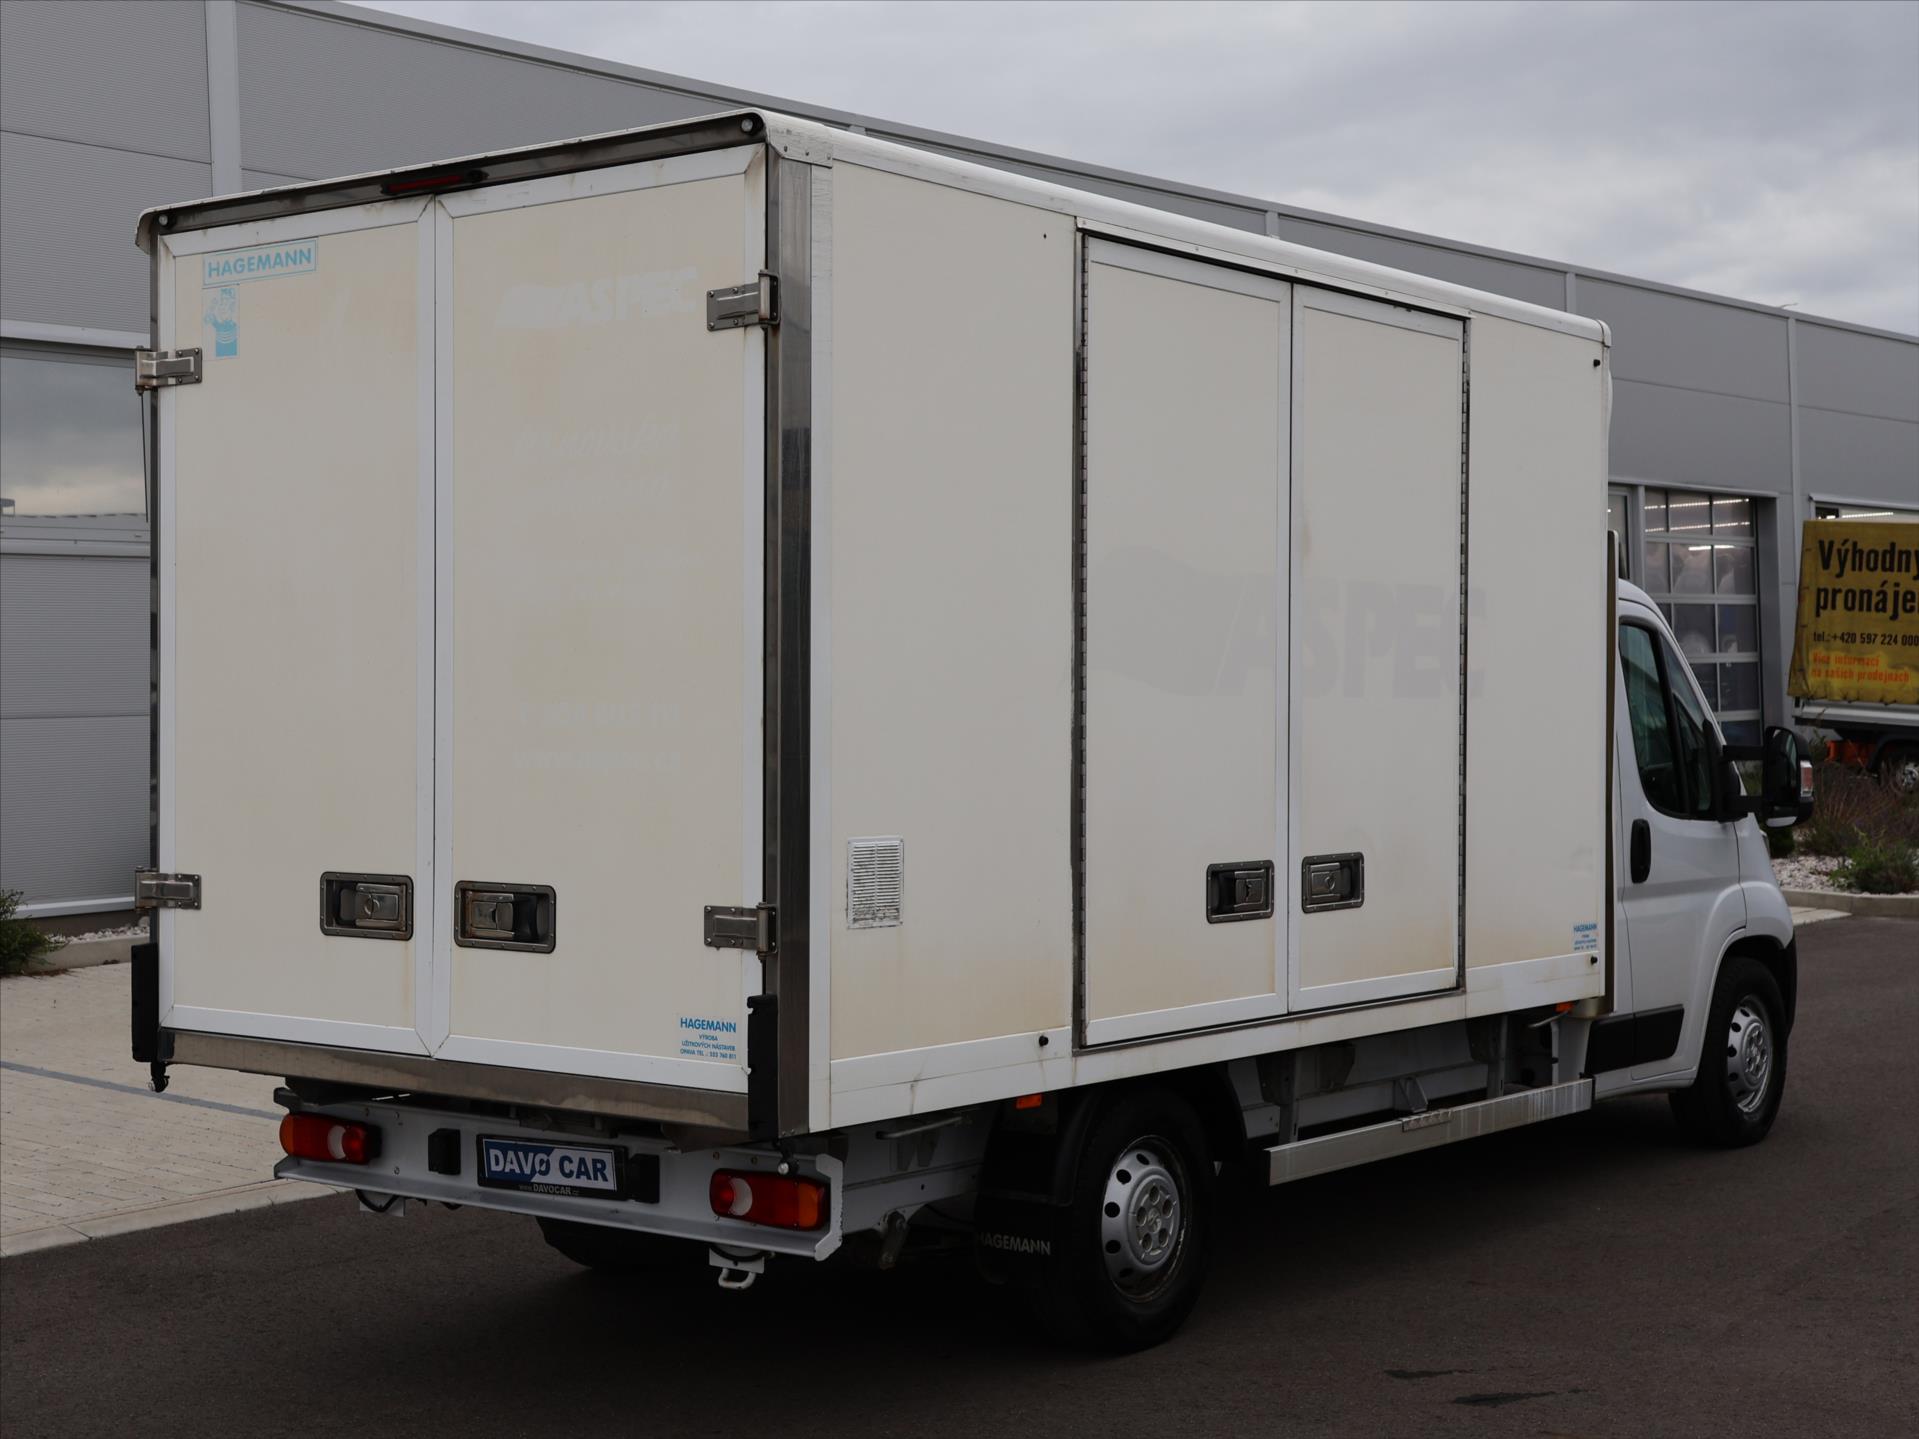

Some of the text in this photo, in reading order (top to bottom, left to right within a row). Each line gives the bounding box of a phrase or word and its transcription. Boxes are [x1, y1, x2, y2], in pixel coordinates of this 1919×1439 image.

[208, 247, 312, 278] HAGEMANN
[1815, 580, 1919, 621] pronáje
[1860, 632, 1878, 645] 597
[1881, 633, 1898, 646] 224
[680, 1017, 737, 1033] HAGEMANN
[558, 1155, 609, 1182] CAR
